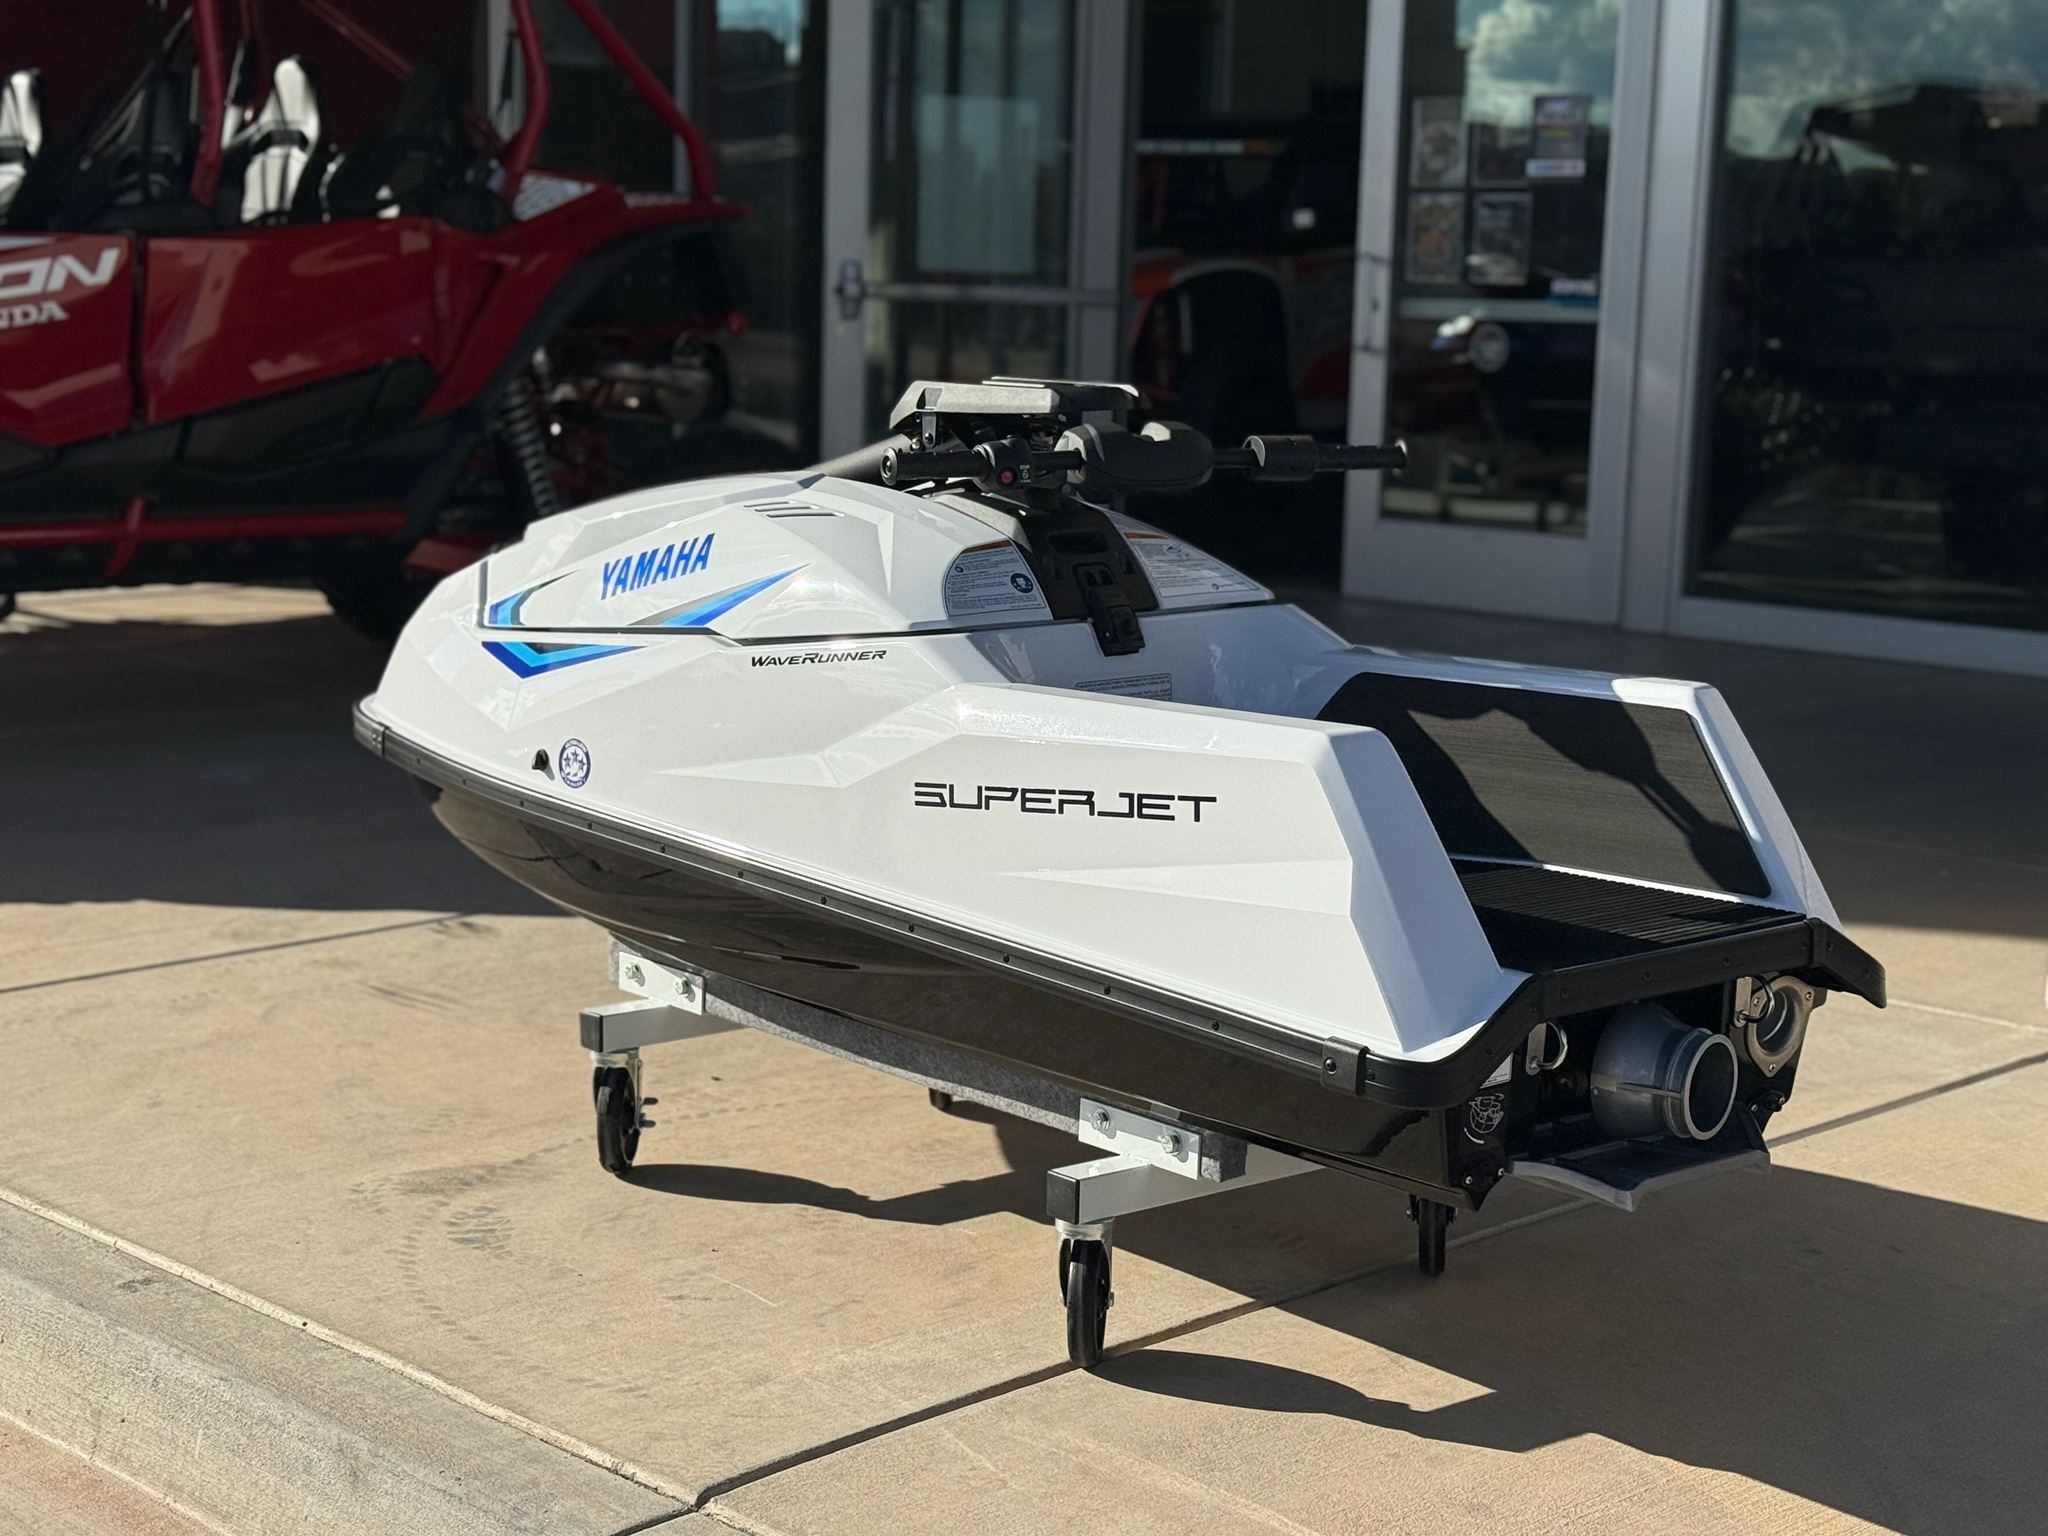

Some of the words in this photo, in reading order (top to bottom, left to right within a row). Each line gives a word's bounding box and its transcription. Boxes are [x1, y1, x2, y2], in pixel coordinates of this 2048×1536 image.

[601, 532, 715, 600] YAMAHA
[751, 650, 887, 667] WAVERUNNER
[914, 782, 1218, 822] SUPERJET
